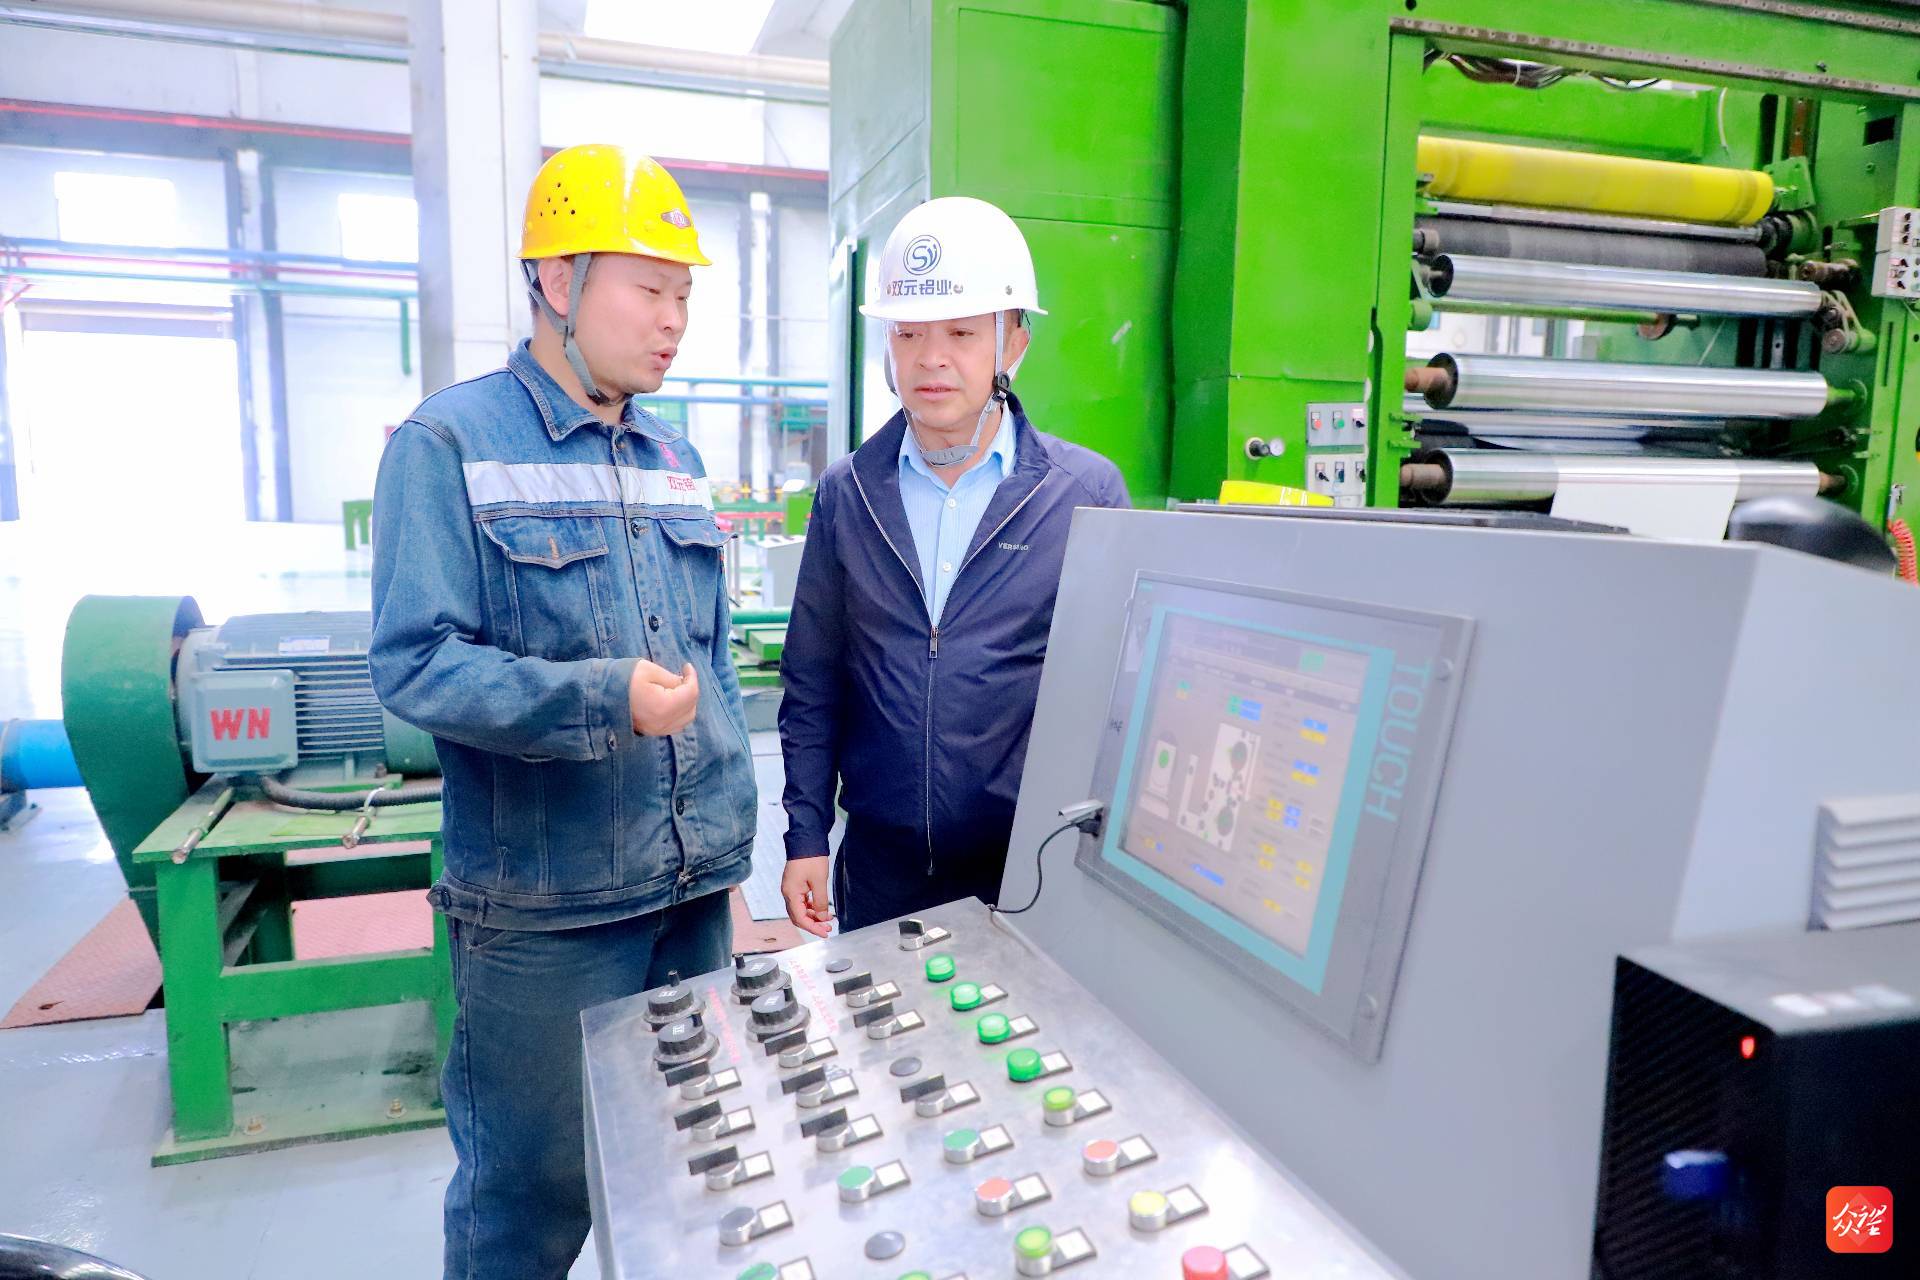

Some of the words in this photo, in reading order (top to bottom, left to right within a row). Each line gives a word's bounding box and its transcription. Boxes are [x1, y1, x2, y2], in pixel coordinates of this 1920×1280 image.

[891, 279, 952, 297] 双元铝业
[210, 706, 271, 741] WN
[1365, 657, 1431, 823] TOUCH
